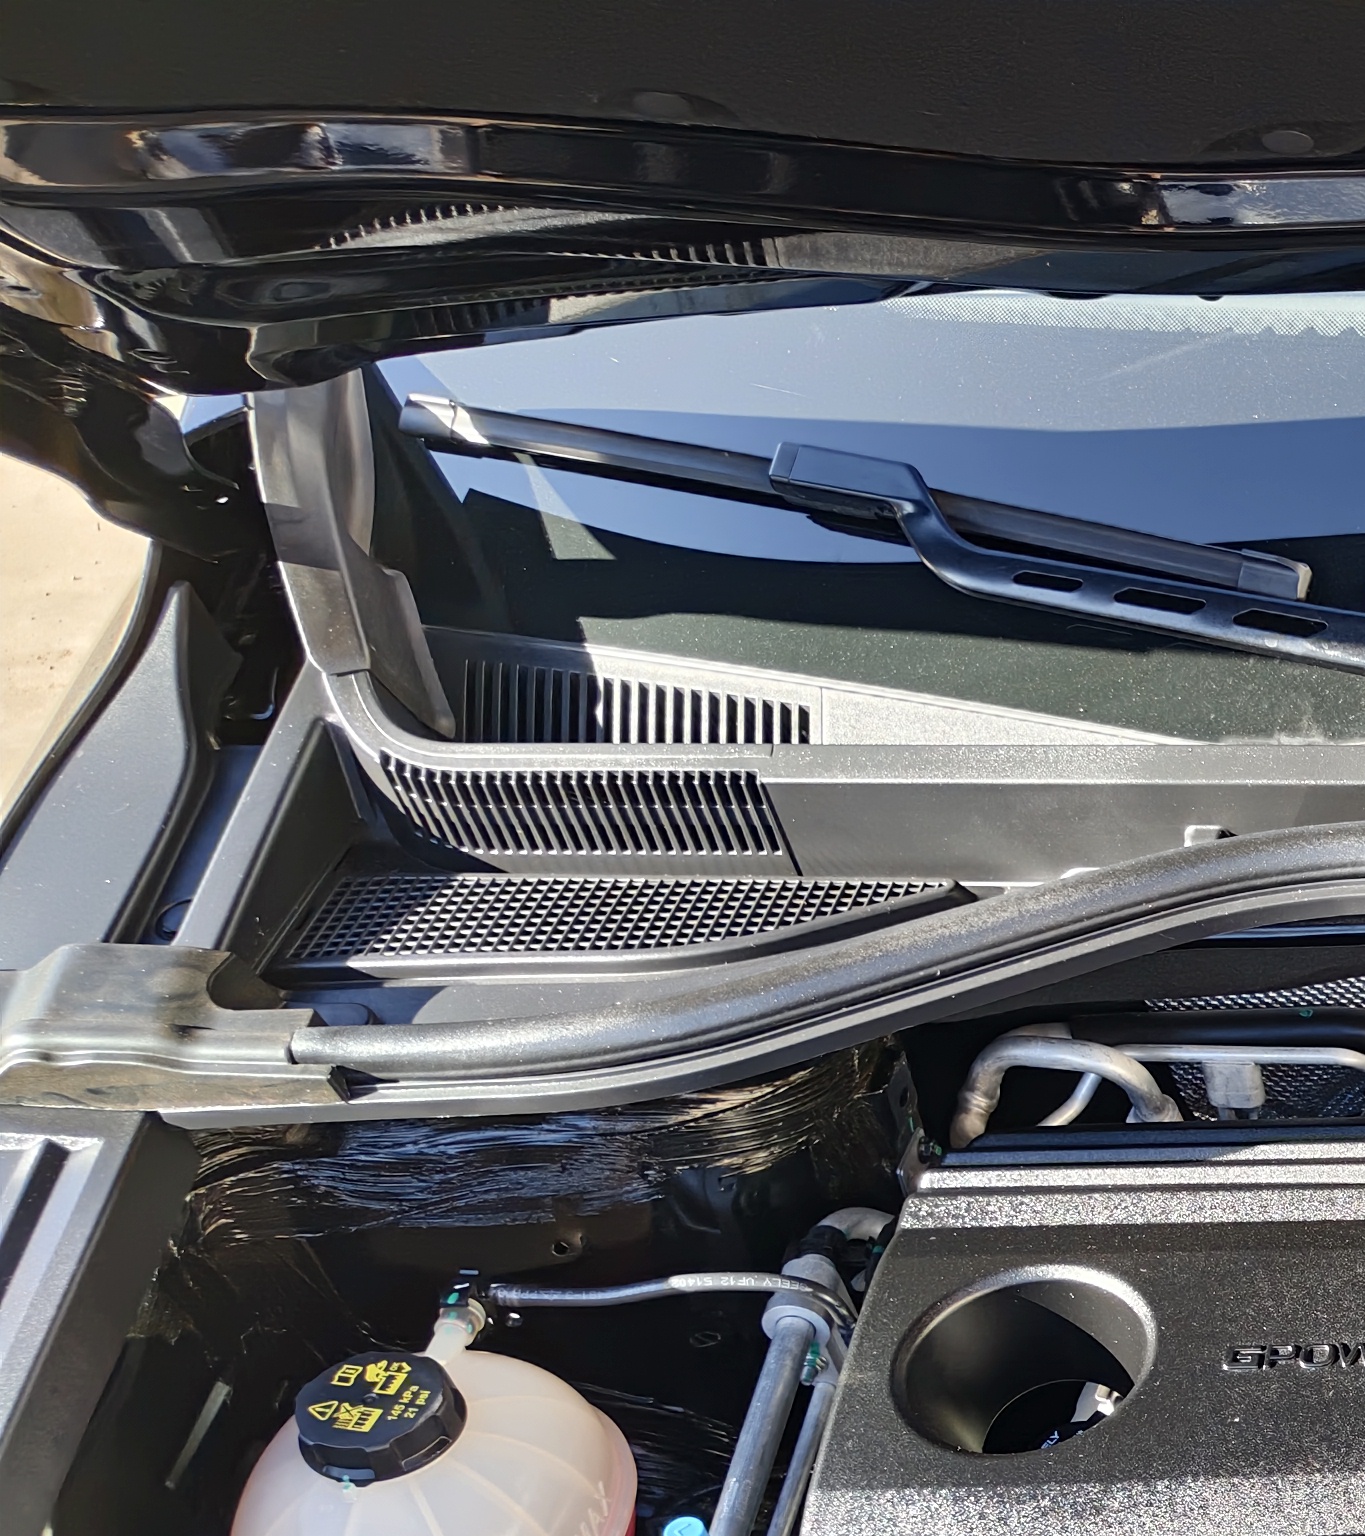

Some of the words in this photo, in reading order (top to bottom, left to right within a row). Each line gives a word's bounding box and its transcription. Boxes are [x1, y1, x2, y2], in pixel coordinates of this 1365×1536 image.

[386, 1404, 406, 1421] 145
[398, 1385, 420, 1403] kPa
[403, 1407, 419, 1419] 21
